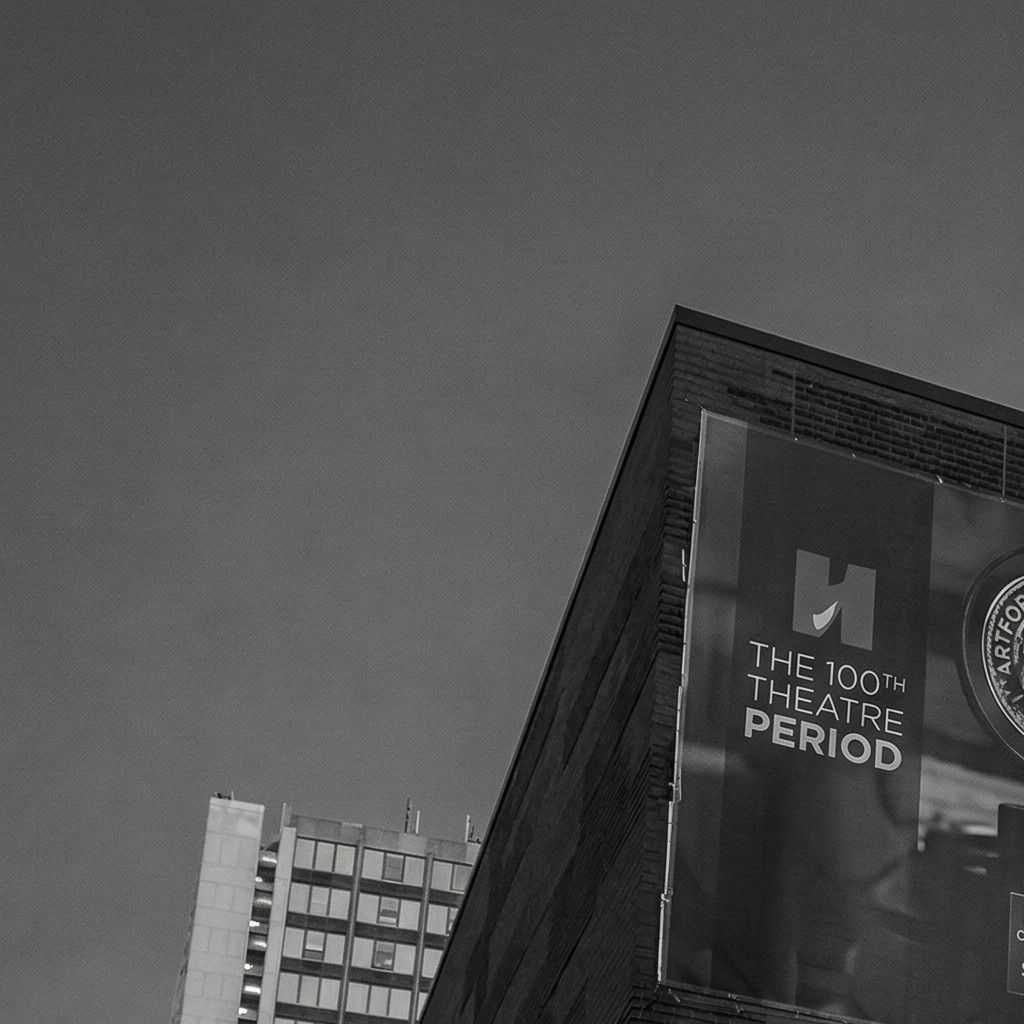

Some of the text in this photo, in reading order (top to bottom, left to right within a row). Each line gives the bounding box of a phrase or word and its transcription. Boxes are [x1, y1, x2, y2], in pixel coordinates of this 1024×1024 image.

[749, 640, 906, 696] THE 100TH
[747, 673, 904, 737] THEATRE
[744, 706, 903, 772] PERIOD
